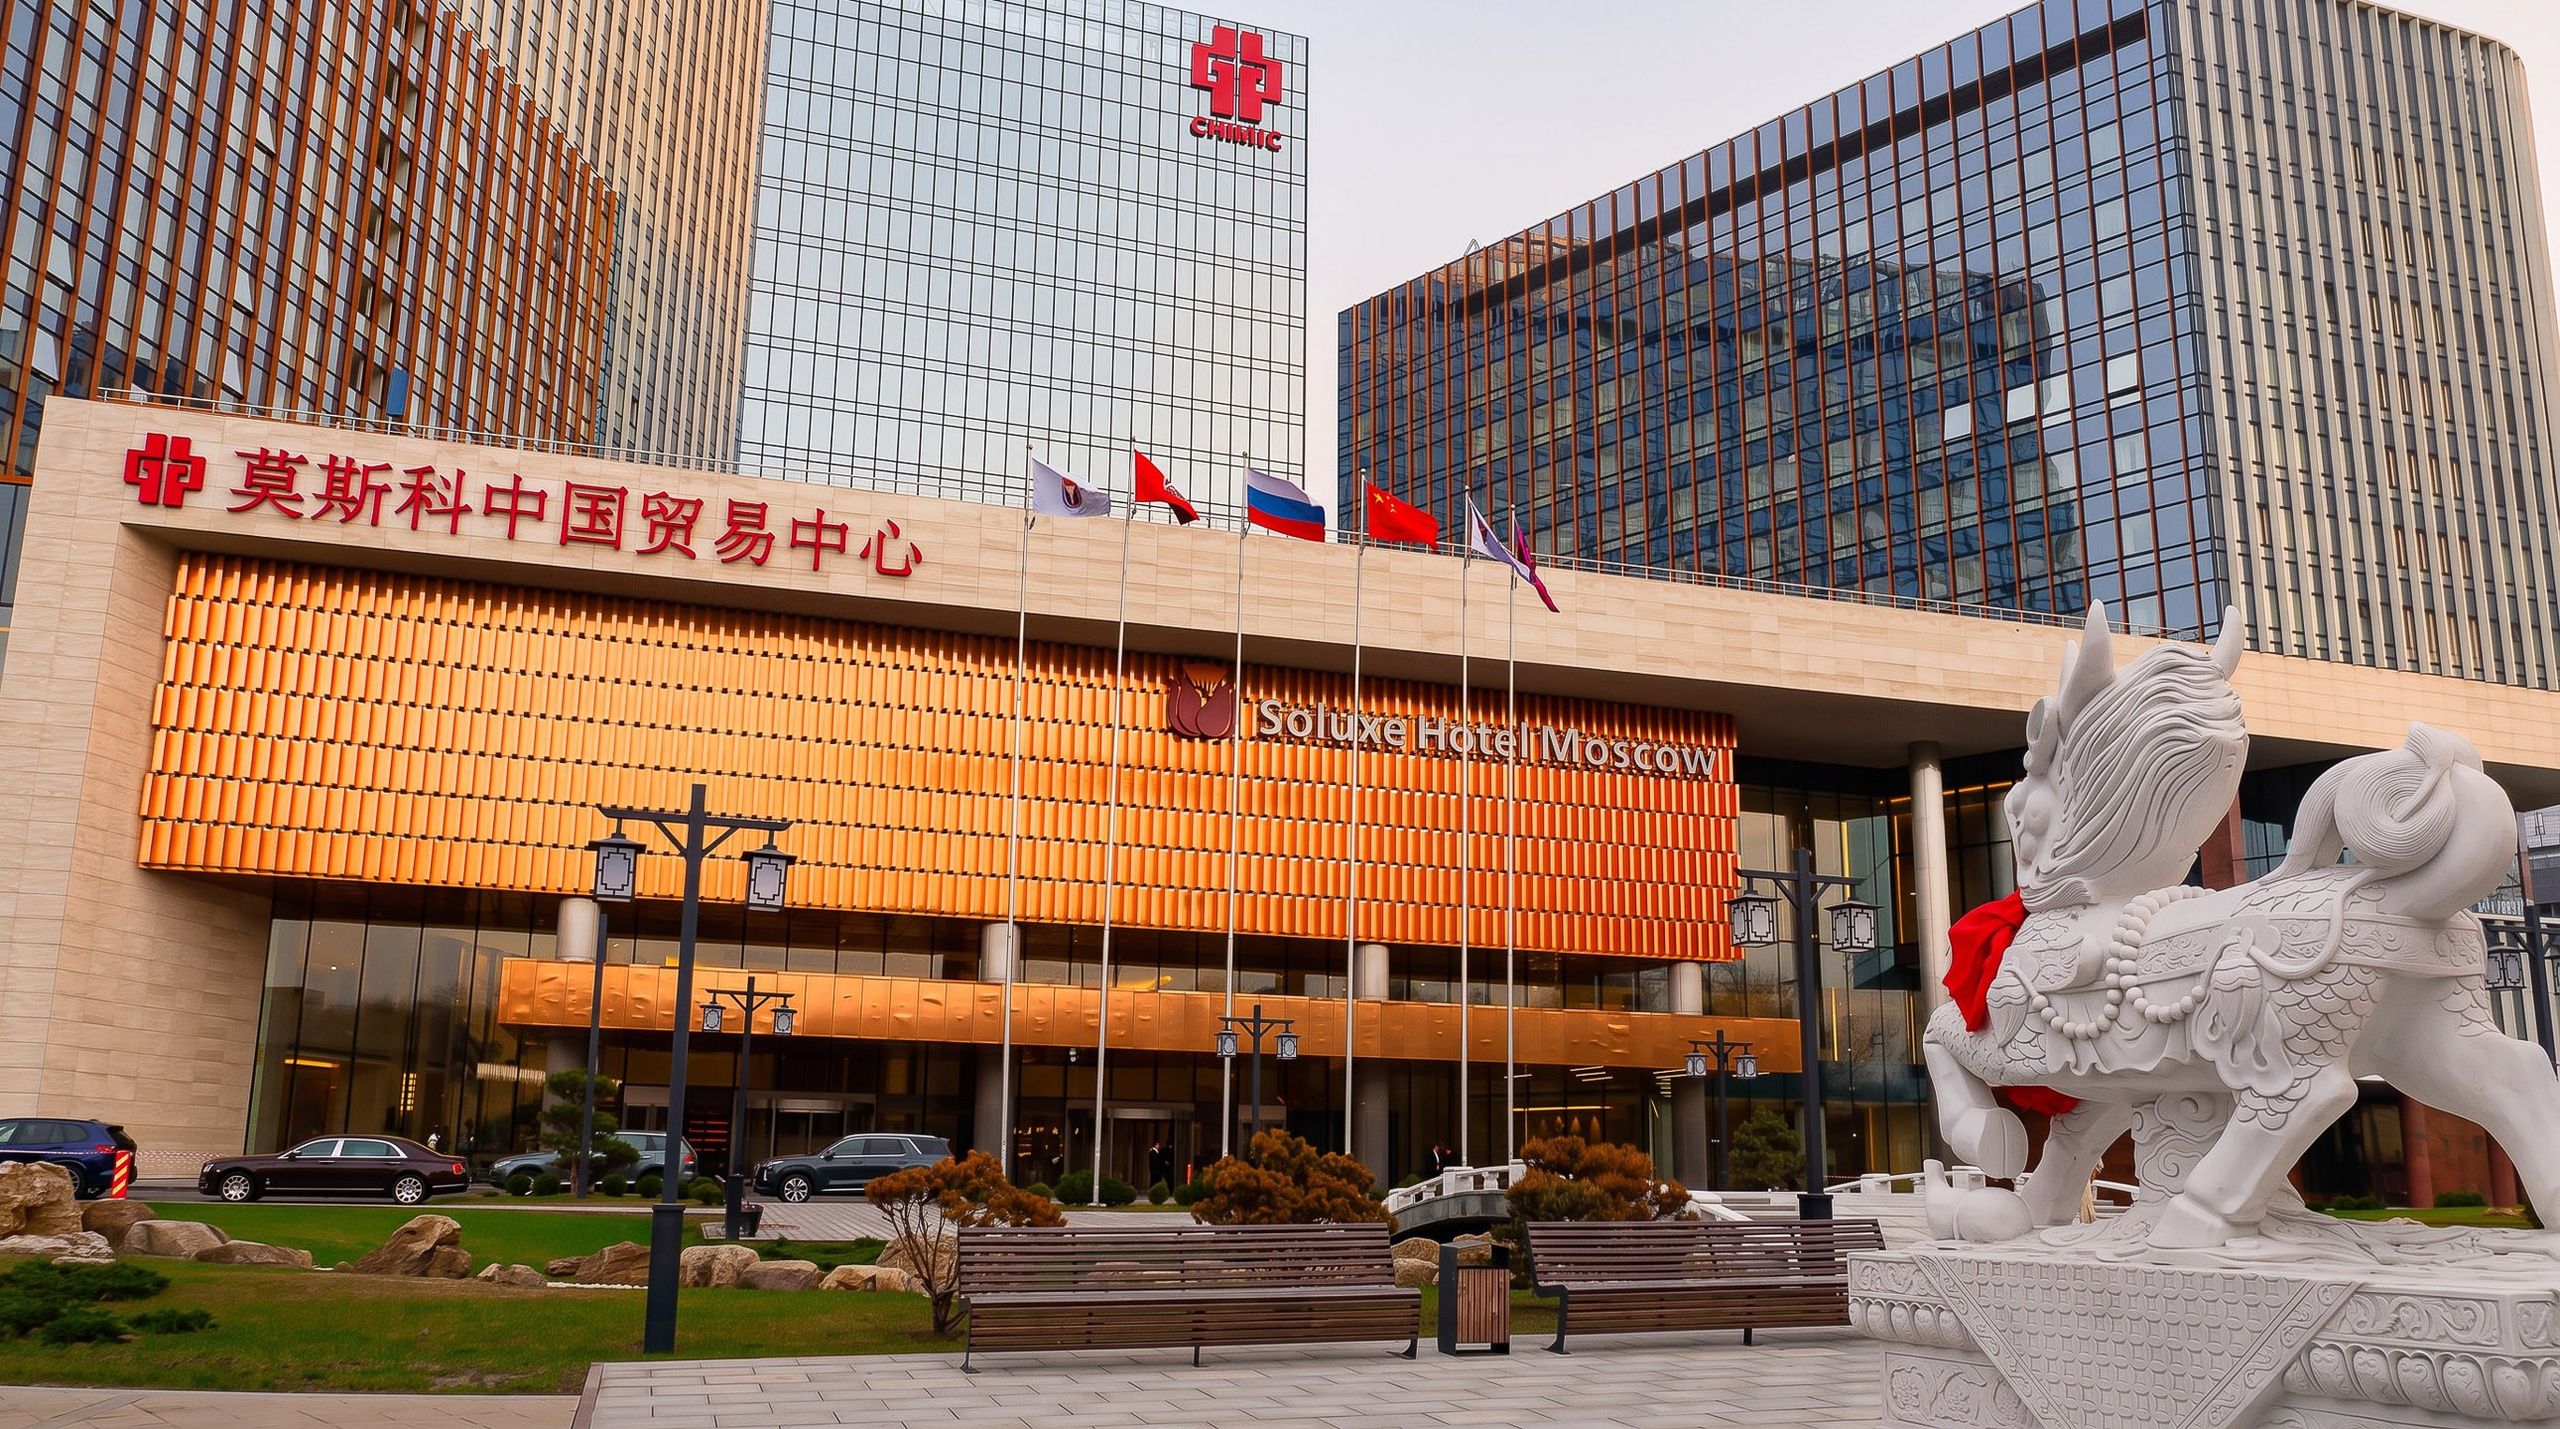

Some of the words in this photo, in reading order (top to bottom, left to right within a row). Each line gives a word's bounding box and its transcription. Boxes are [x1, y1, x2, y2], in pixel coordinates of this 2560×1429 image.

[227, 446, 924, 578] 莫斯科中国贸易中心
[1259, 699, 1407, 747] Soluxe
[1417, 714, 1529, 759] Hotel
[1541, 723, 1717, 776] Moscow
